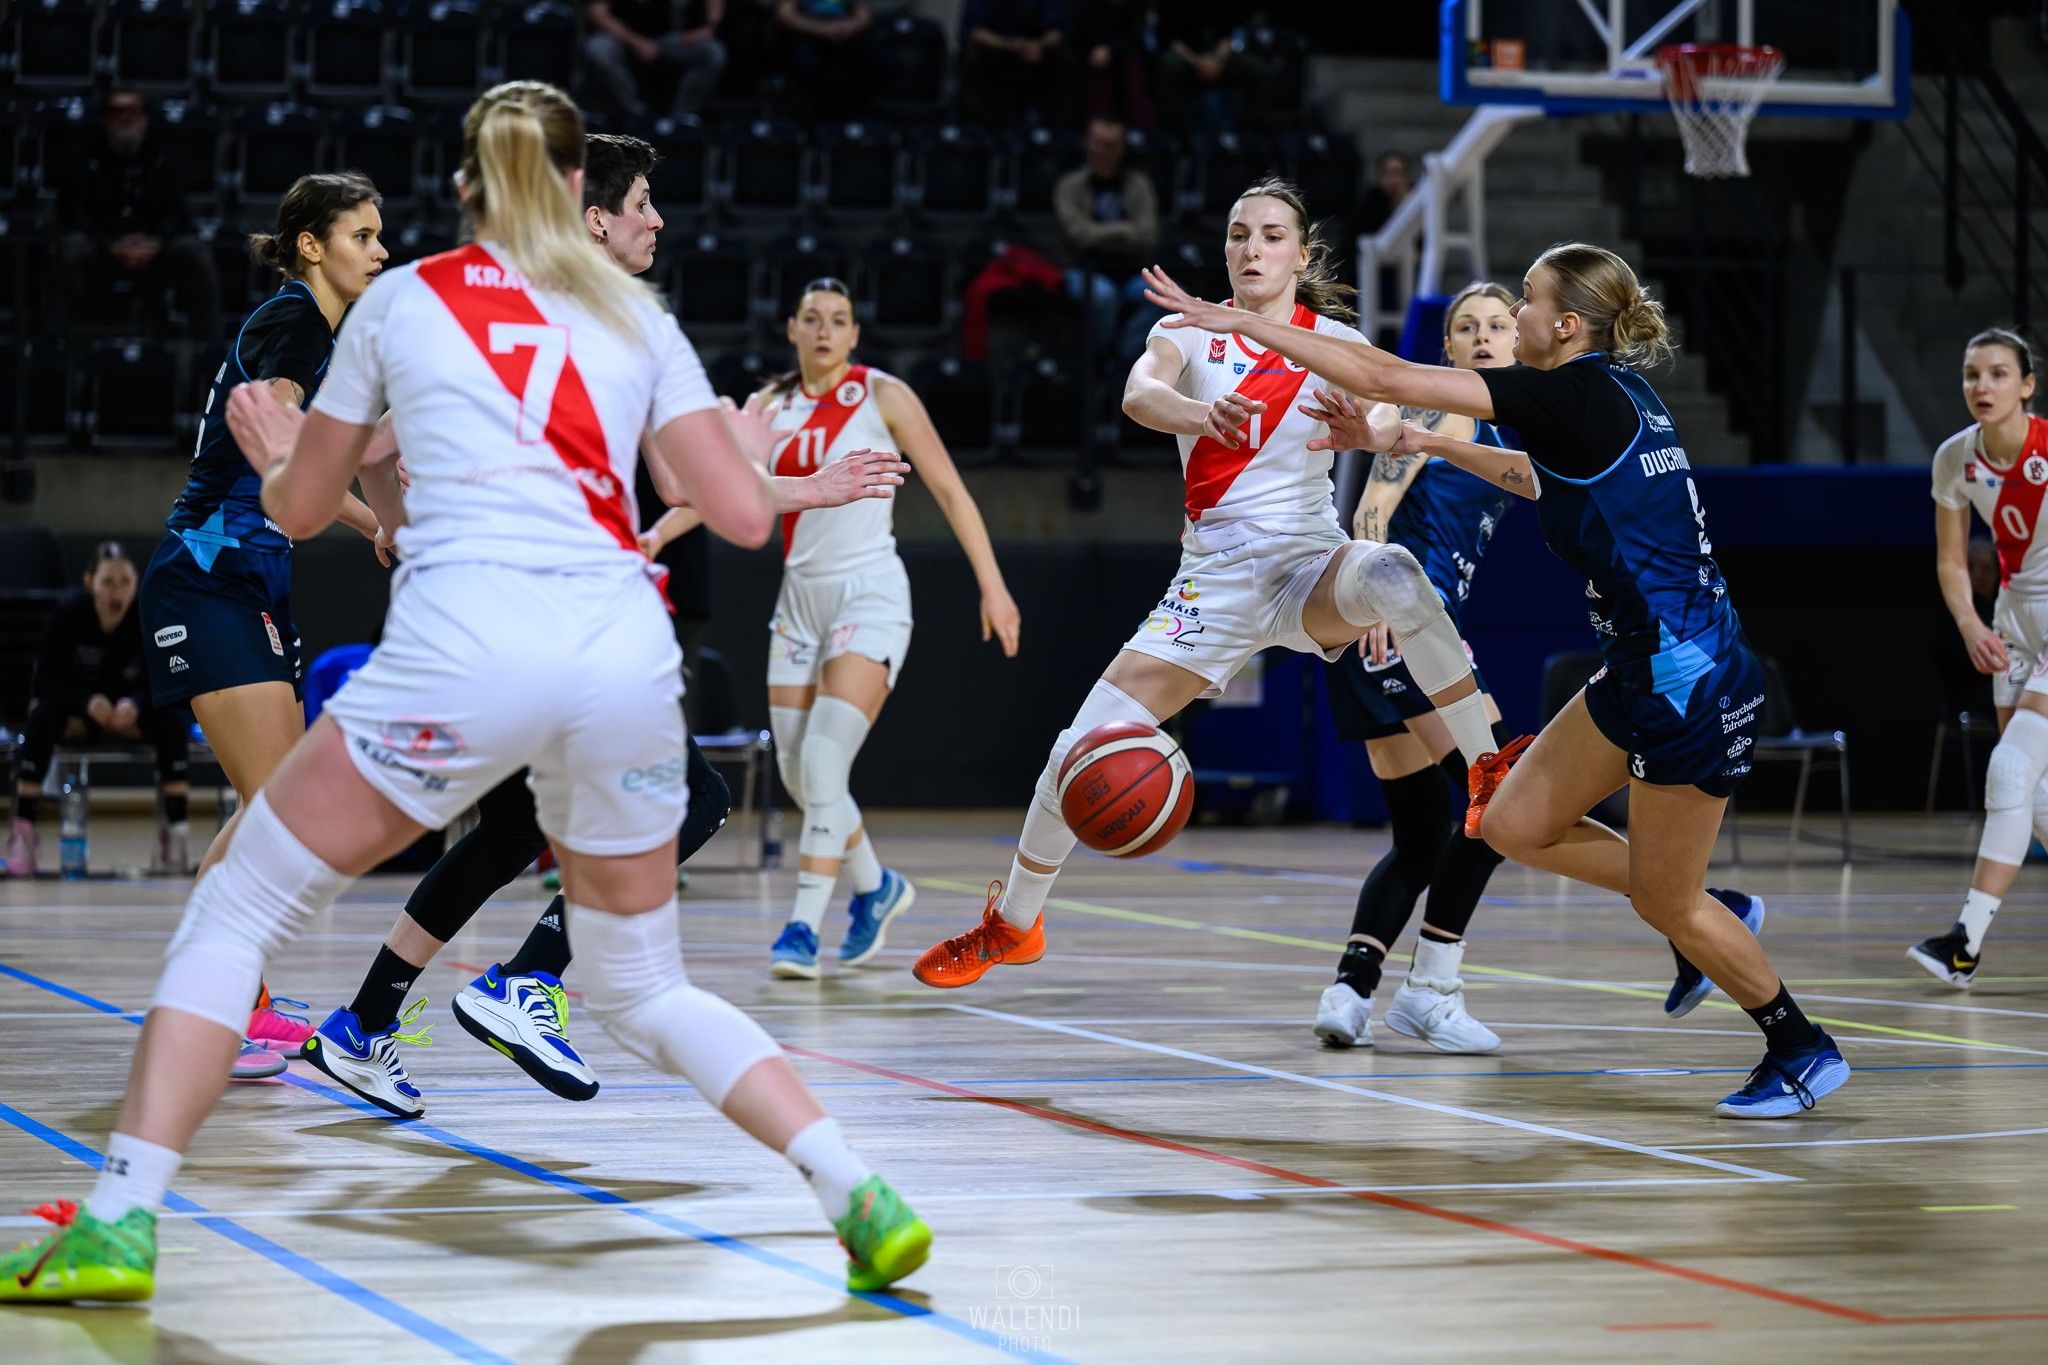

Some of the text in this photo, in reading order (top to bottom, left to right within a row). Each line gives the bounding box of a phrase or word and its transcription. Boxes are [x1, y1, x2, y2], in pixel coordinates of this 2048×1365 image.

[487, 321, 572, 446] 7
[798, 427, 827, 468] 11
[2001, 504, 2030, 540] 0
[156, 629, 183, 644] Moreso
[1721, 693, 1765, 724] Przychodnia
[1722, 712, 1755, 734] Zdrowie
[1097, 797, 1147, 840] molten
[1761, 1006, 1788, 1026] 23
